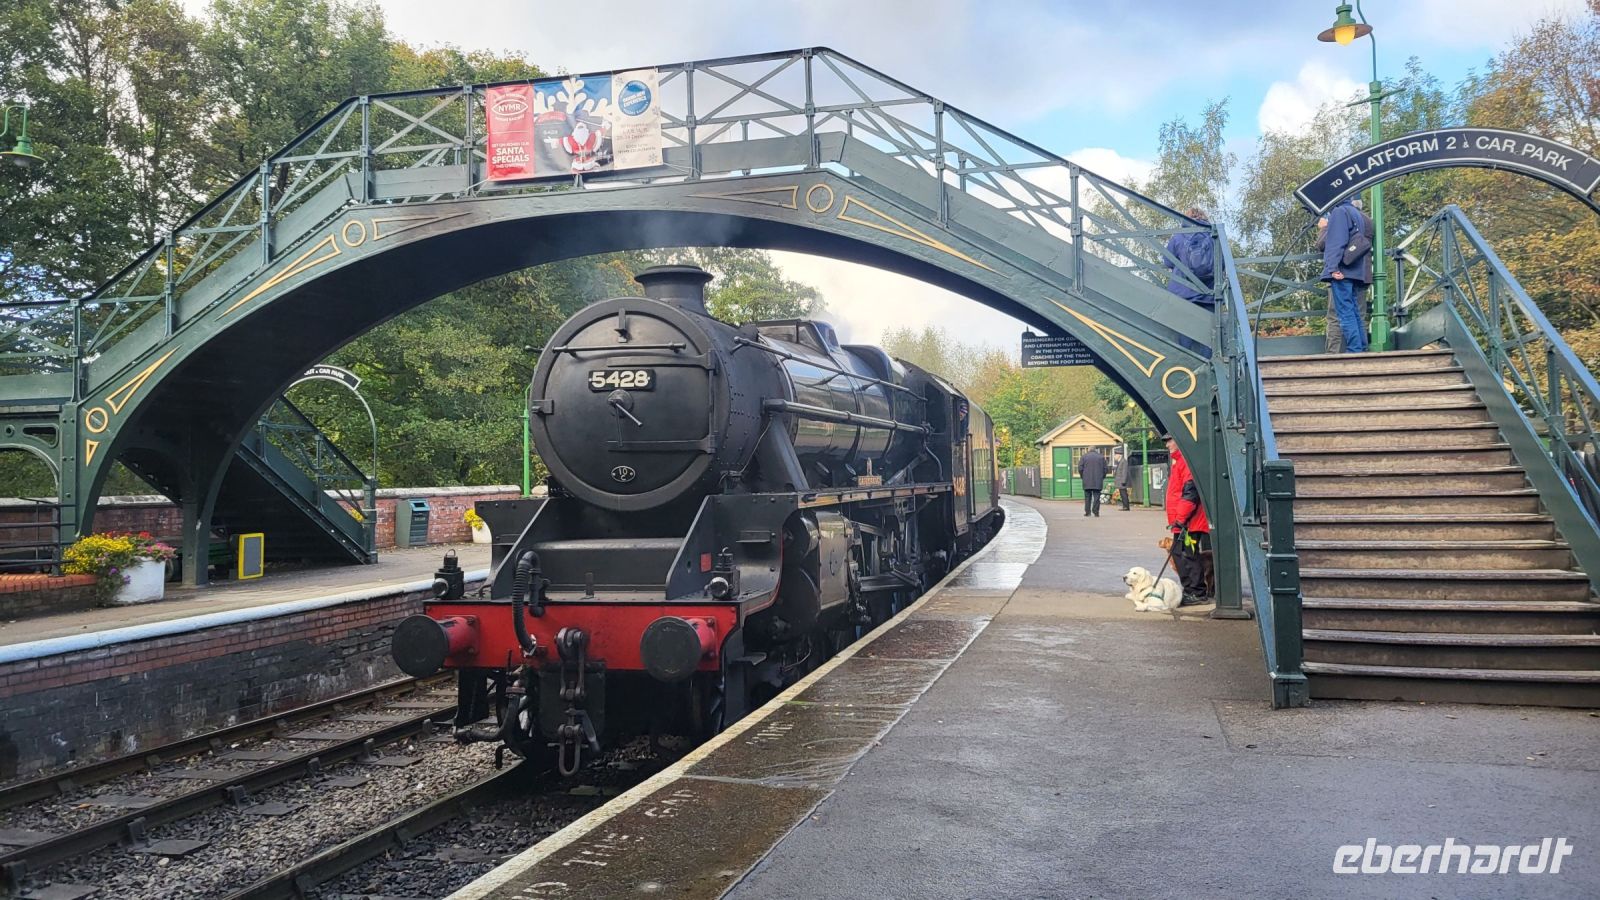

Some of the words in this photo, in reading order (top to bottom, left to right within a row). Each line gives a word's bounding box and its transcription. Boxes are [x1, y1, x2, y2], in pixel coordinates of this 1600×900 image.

[498, 104, 521, 112] NYMR
[496, 146, 525, 155] SANTA
[491, 154, 530, 164] SPECIALS
[1329, 178, 1343, 189] TO
[1343, 137, 1439, 181] PLATFORM
[1446, 136, 1457, 150] 2
[1463, 140, 1470, 149] &
[1475, 135, 1517, 152] CAR
[1521, 143, 1573, 172] PARK
[331, 369, 345, 380] PARK
[591, 370, 649, 388] 5428
